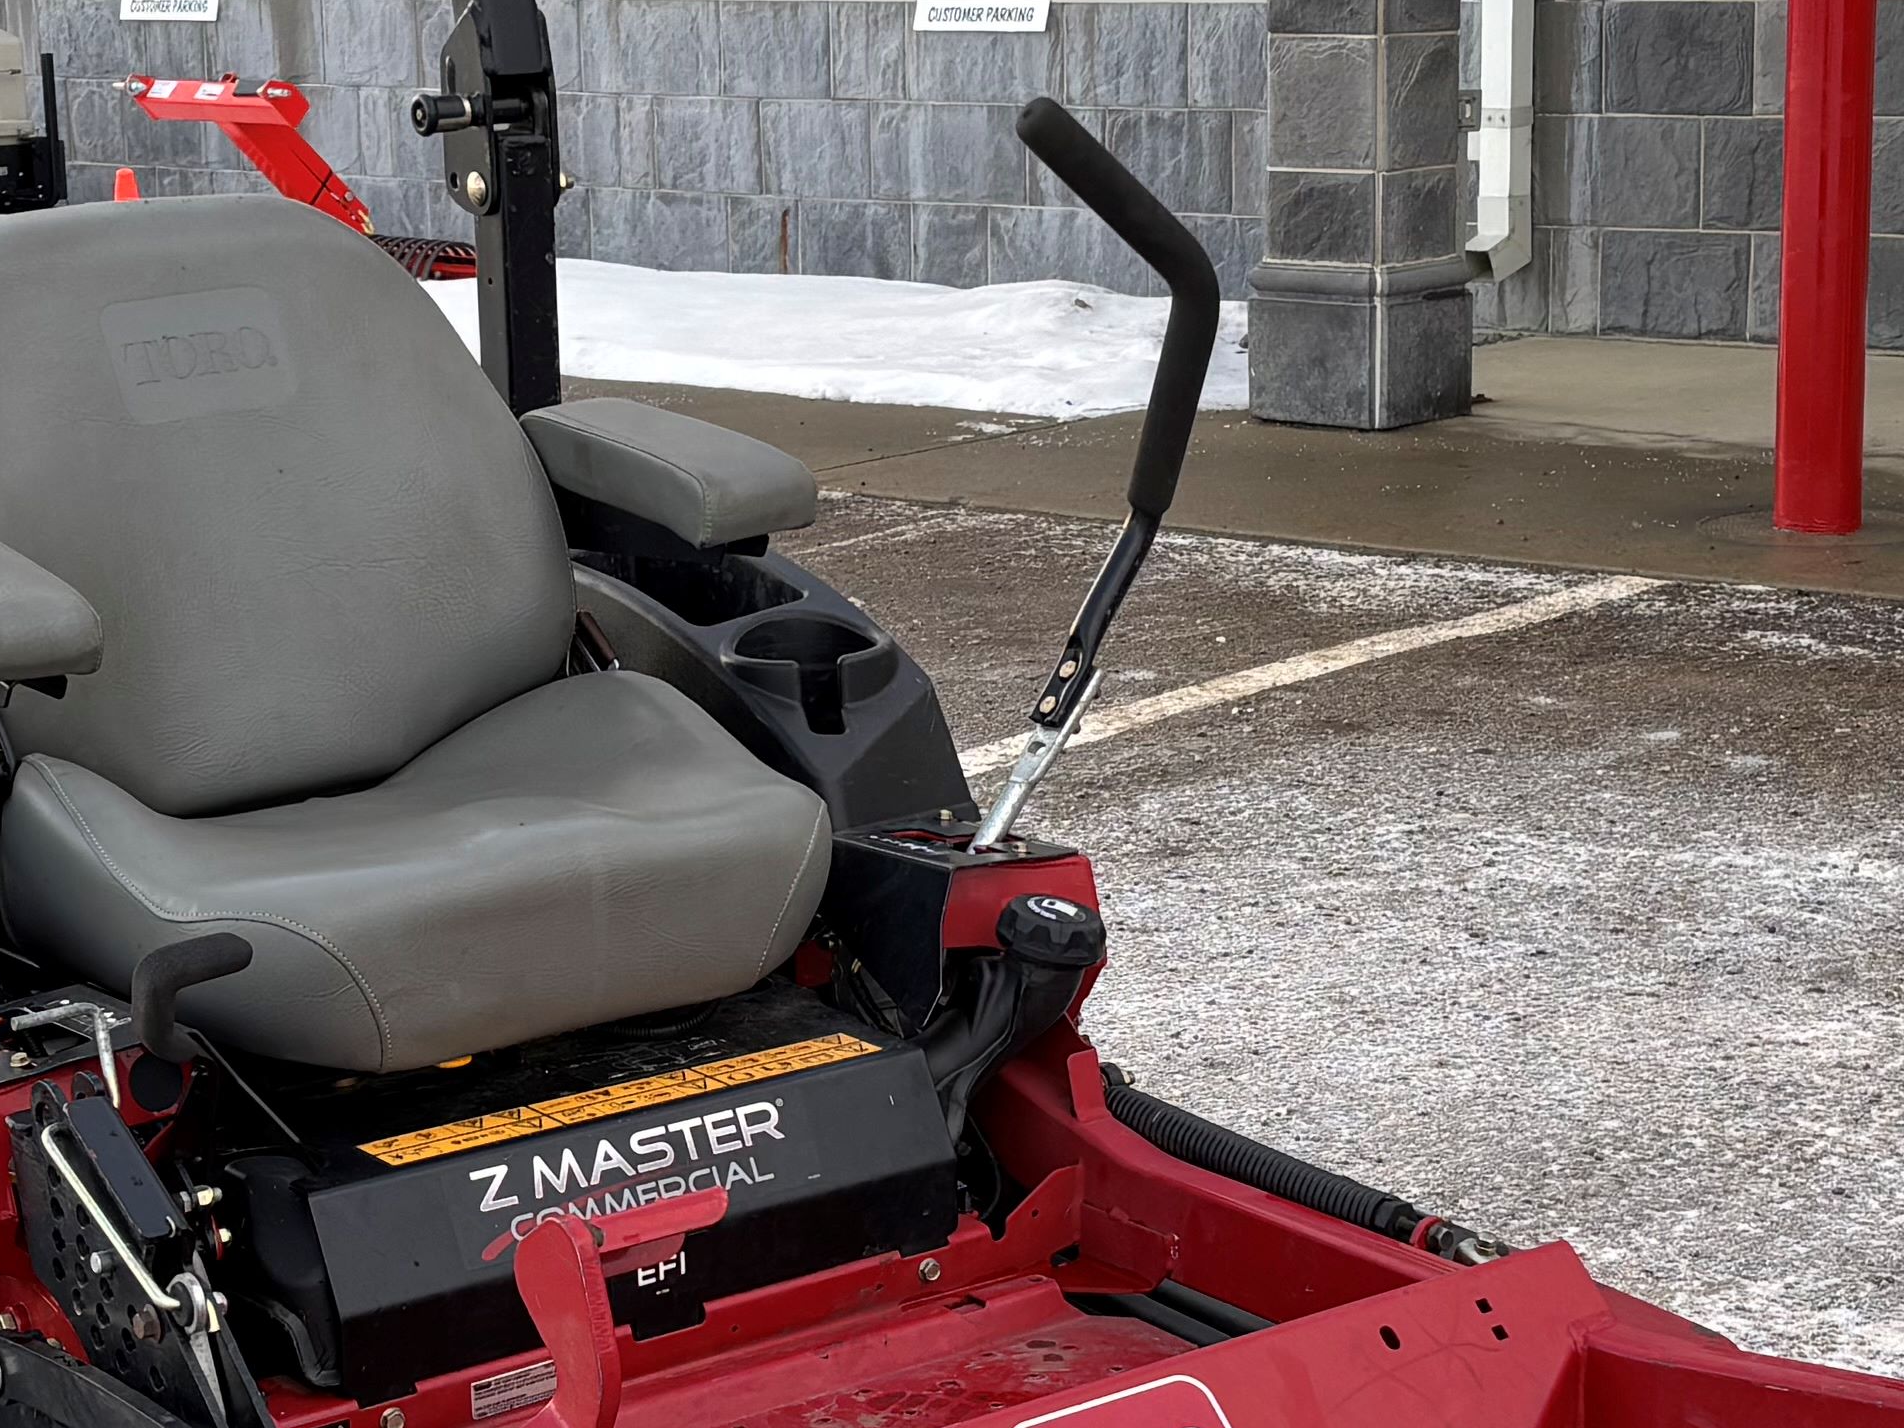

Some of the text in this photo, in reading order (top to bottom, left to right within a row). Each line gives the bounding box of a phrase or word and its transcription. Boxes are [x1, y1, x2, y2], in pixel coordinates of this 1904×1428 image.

[130, 0, 208, 13] CUSTOMER PARKING
[928, 6, 1035, 22] CUSTOMER PARKING
[469, 1101, 786, 1212] Z MASTER
[637, 1251, 686, 1287] EFI
